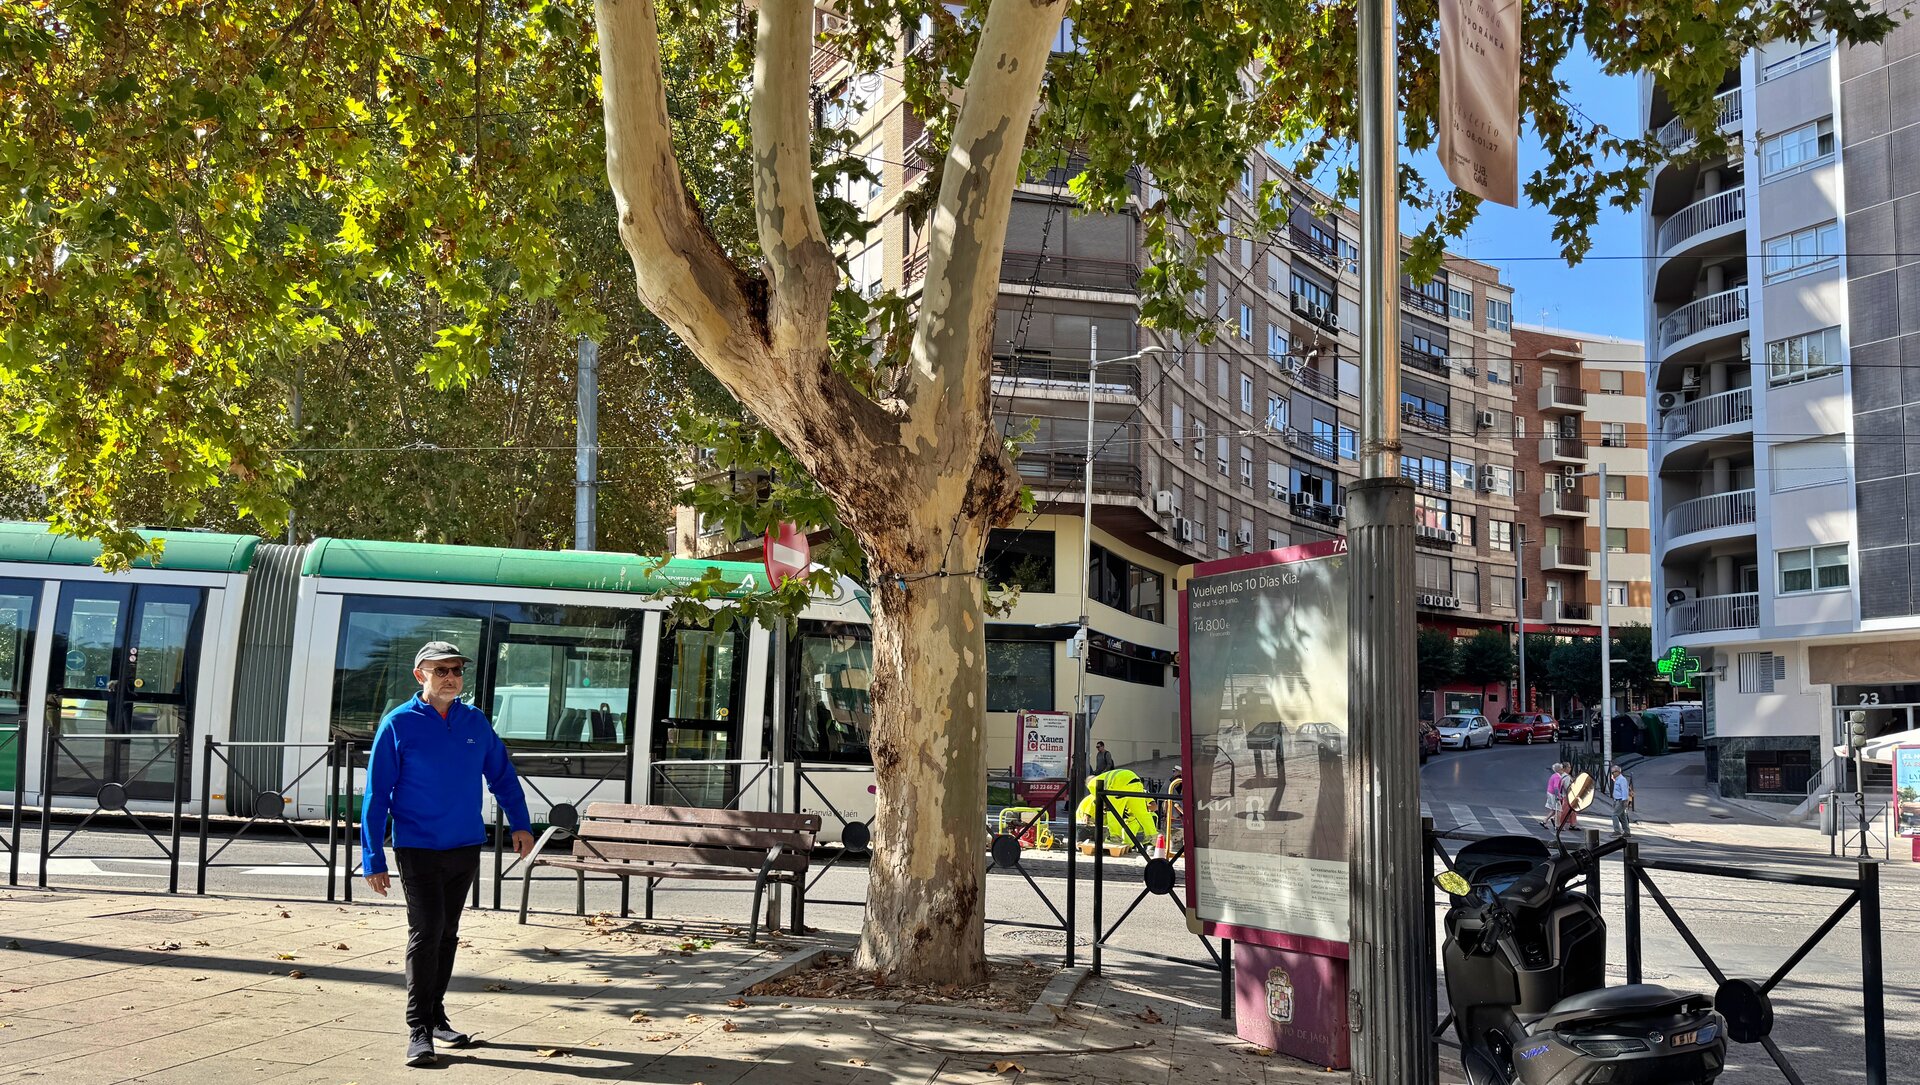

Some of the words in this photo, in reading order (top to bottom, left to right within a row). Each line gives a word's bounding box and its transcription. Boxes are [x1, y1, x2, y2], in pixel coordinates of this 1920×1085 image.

[1466, 38, 1485, 57] JAÉN
[1332, 539, 1348, 552] 7A
[1192, 584, 1228, 597] Vuelven
[1230, 581, 1243, 592] los
[1245, 578, 1257, 590] 10
[1259, 575, 1280, 589] Días
[1282, 572, 1300, 584] Kia.
[1192, 601, 1202, 609] Del
[1860, 692, 1880, 708] 23
[1040, 735, 1064, 744] Xauen
[1040, 743, 1064, 752] Clima
[808, 808, 833, 817] Tranvía
[843, 809, 858, 818] Jaén
